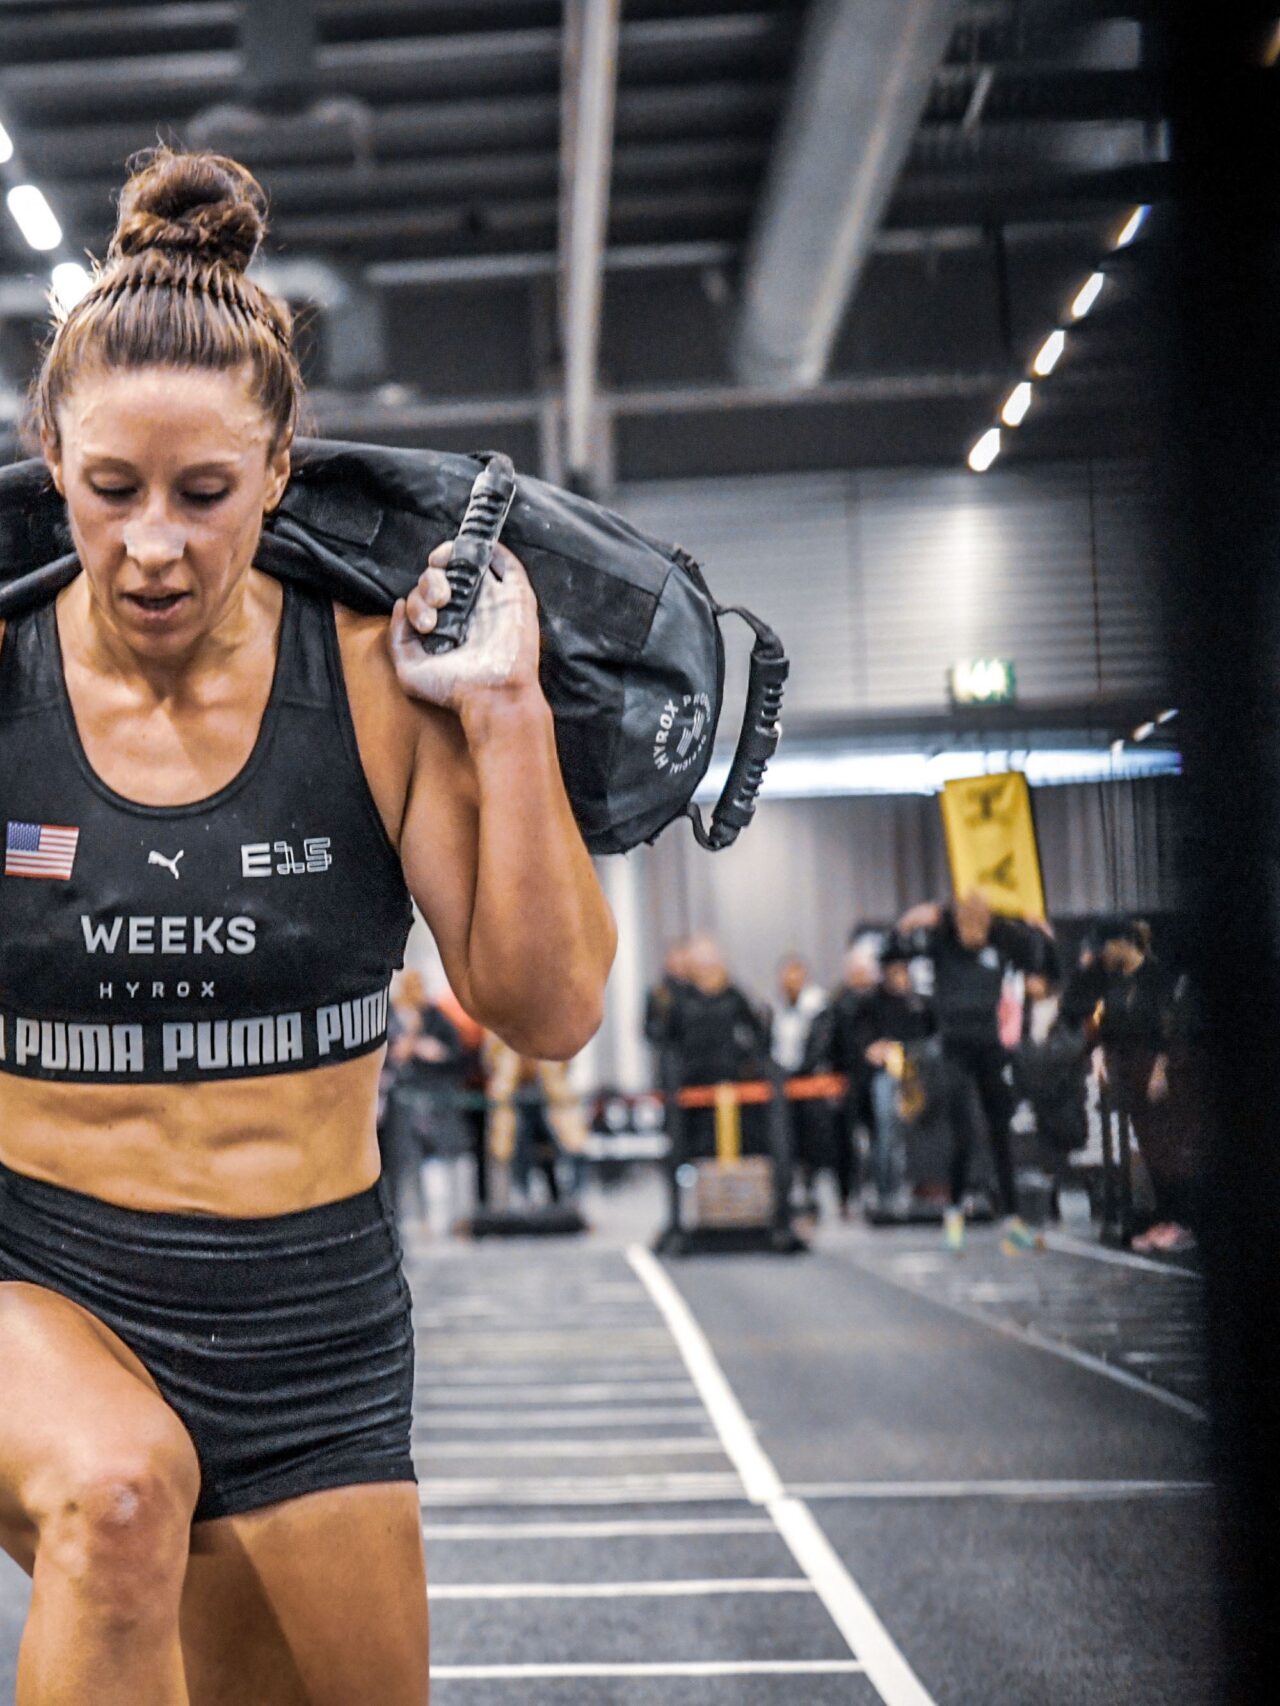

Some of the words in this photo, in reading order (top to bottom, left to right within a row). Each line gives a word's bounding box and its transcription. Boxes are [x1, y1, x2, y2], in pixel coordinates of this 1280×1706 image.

[653, 698, 679, 769] HYROX
[240, 837, 332, 878] E15
[80, 914, 257, 955] WEEKS
[99, 981, 216, 999] HYROX
[16, 1016, 145, 1073] PUMA
[162, 1011, 304, 1072] PUMA
[316, 986, 388, 1056] PUM
